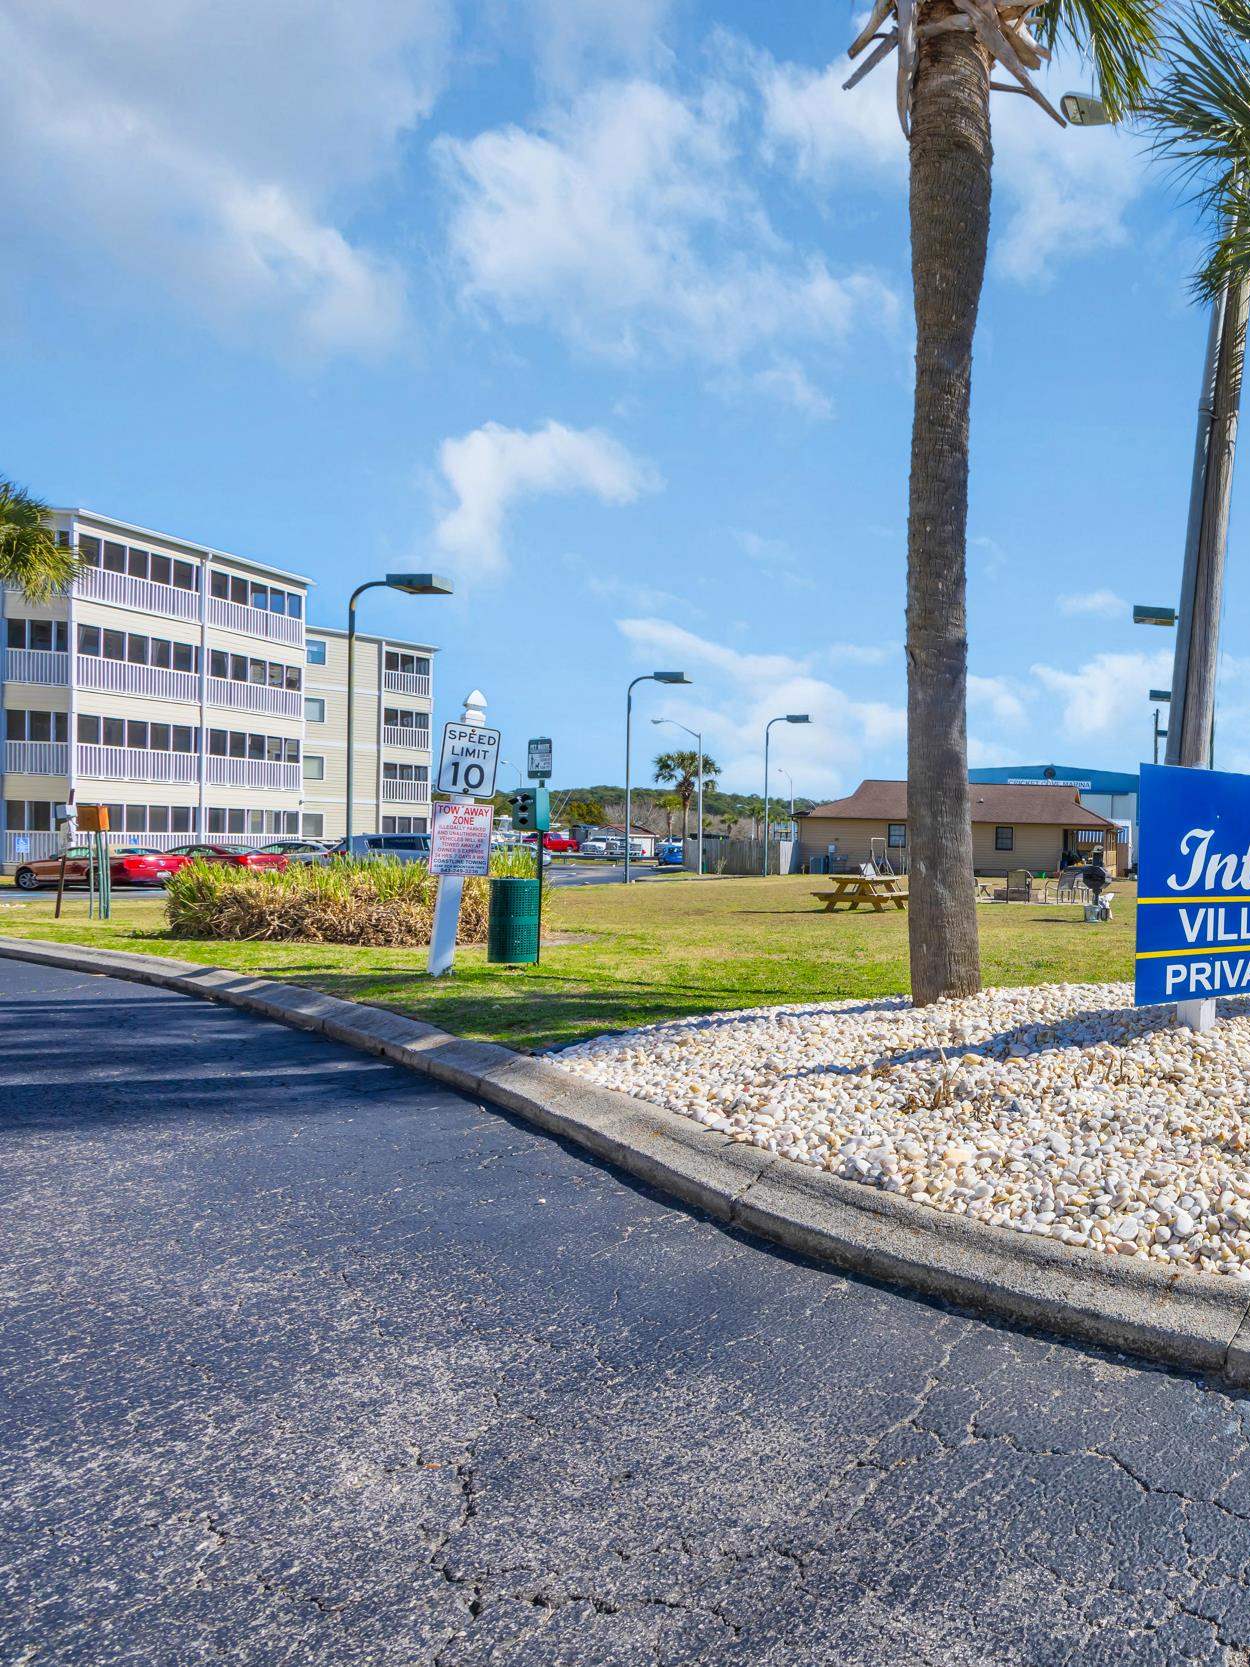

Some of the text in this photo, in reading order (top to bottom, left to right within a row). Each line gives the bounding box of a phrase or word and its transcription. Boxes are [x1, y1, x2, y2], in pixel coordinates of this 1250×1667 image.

[448, 729, 496, 746] SPEED
[451, 745, 489, 760] LIMIT
[451, 761, 485, 789] 10
[438, 805, 490, 817] TOW AWAY
[452, 816, 474, 825] ZONE
